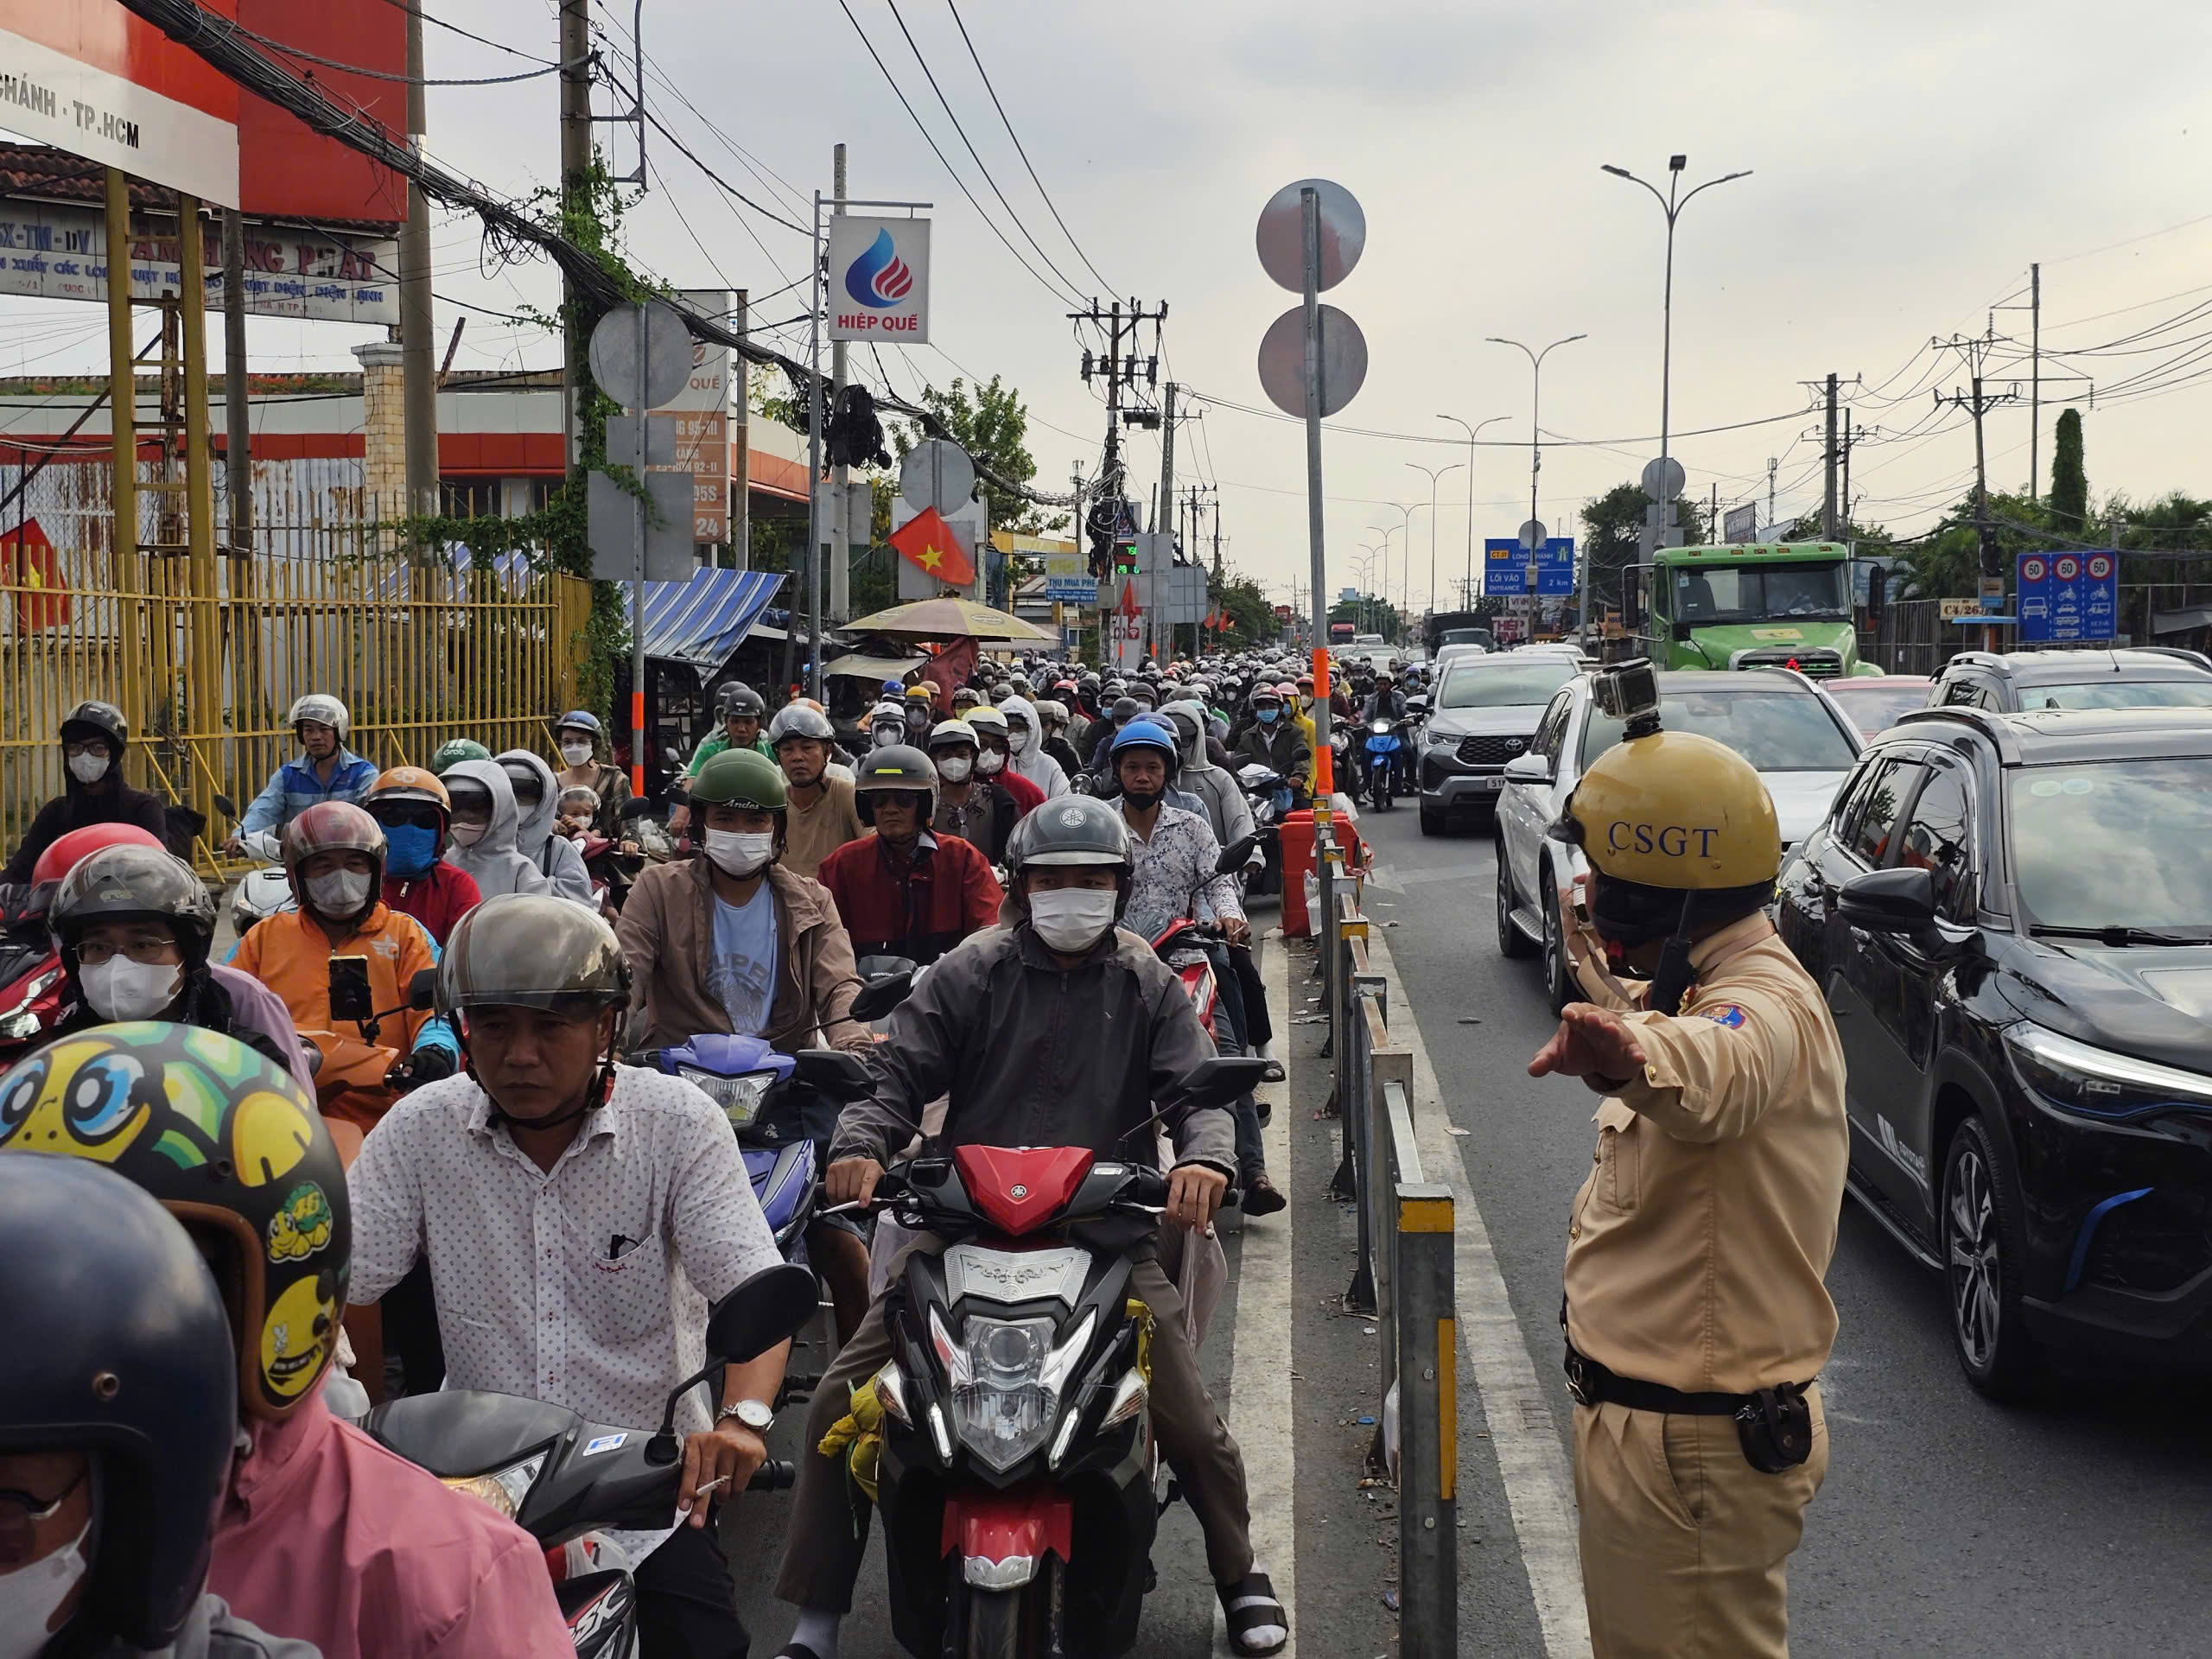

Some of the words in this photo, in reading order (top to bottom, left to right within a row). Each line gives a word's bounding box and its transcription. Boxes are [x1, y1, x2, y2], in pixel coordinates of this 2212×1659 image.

[0, 73, 56, 118] HÁNH
[73, 100, 139, 149] TP.HCM
[54, 260, 79, 276] CÁC
[131, 269, 160, 285] UẠT
[837, 312, 878, 332] HIỆP
[882, 314, 918, 332] QUẾ
[690, 375, 719, 390] QUẾ
[2029, 564, 2039, 575] 60
[2062, 563, 2072, 574] 60
[2094, 562, 2105, 573] 60
[722, 799, 760, 809] Andes
[1609, 822, 1719, 858] CSGT
